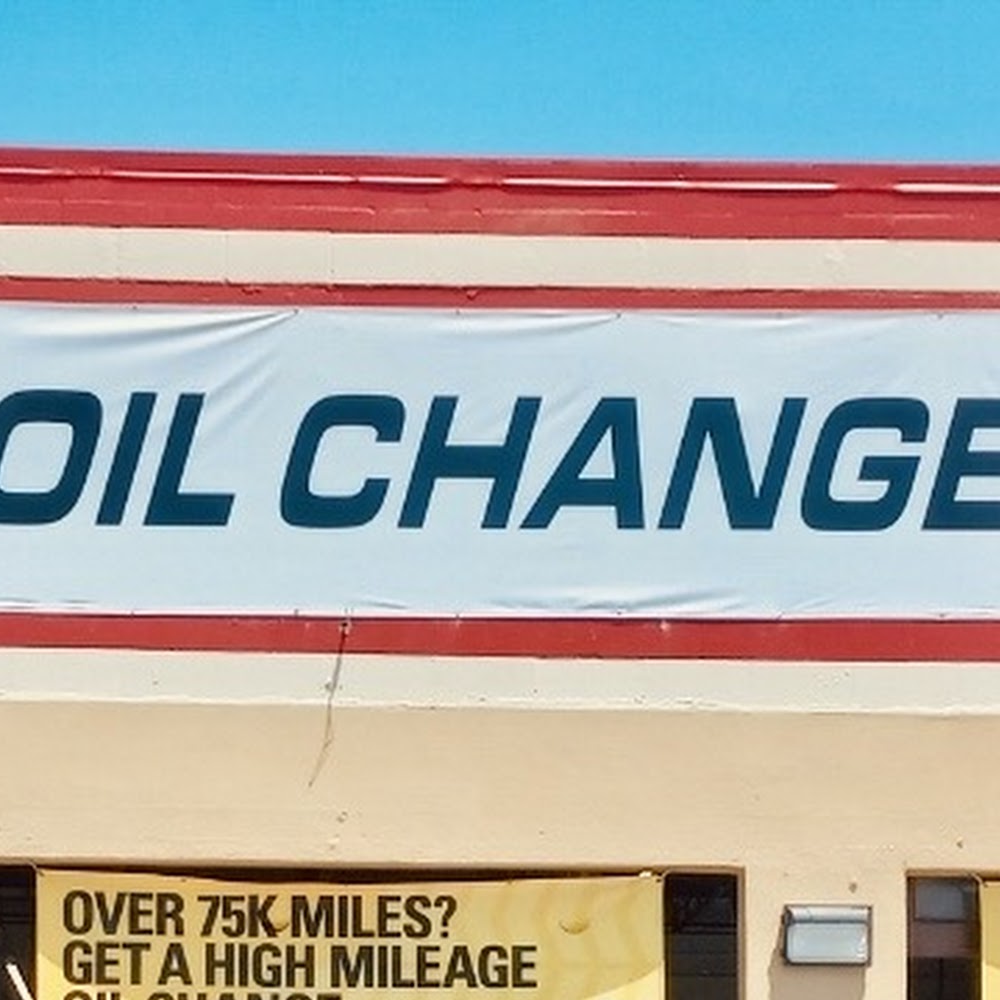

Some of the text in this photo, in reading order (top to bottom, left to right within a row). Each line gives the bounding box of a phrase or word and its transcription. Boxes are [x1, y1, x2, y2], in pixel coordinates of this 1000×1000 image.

[279, 394, 1000, 531] CHANGE
[62, 890, 458, 939] OVER 75K MILES?
[62, 941, 538, 989] GET A HIGH MILEAGE
